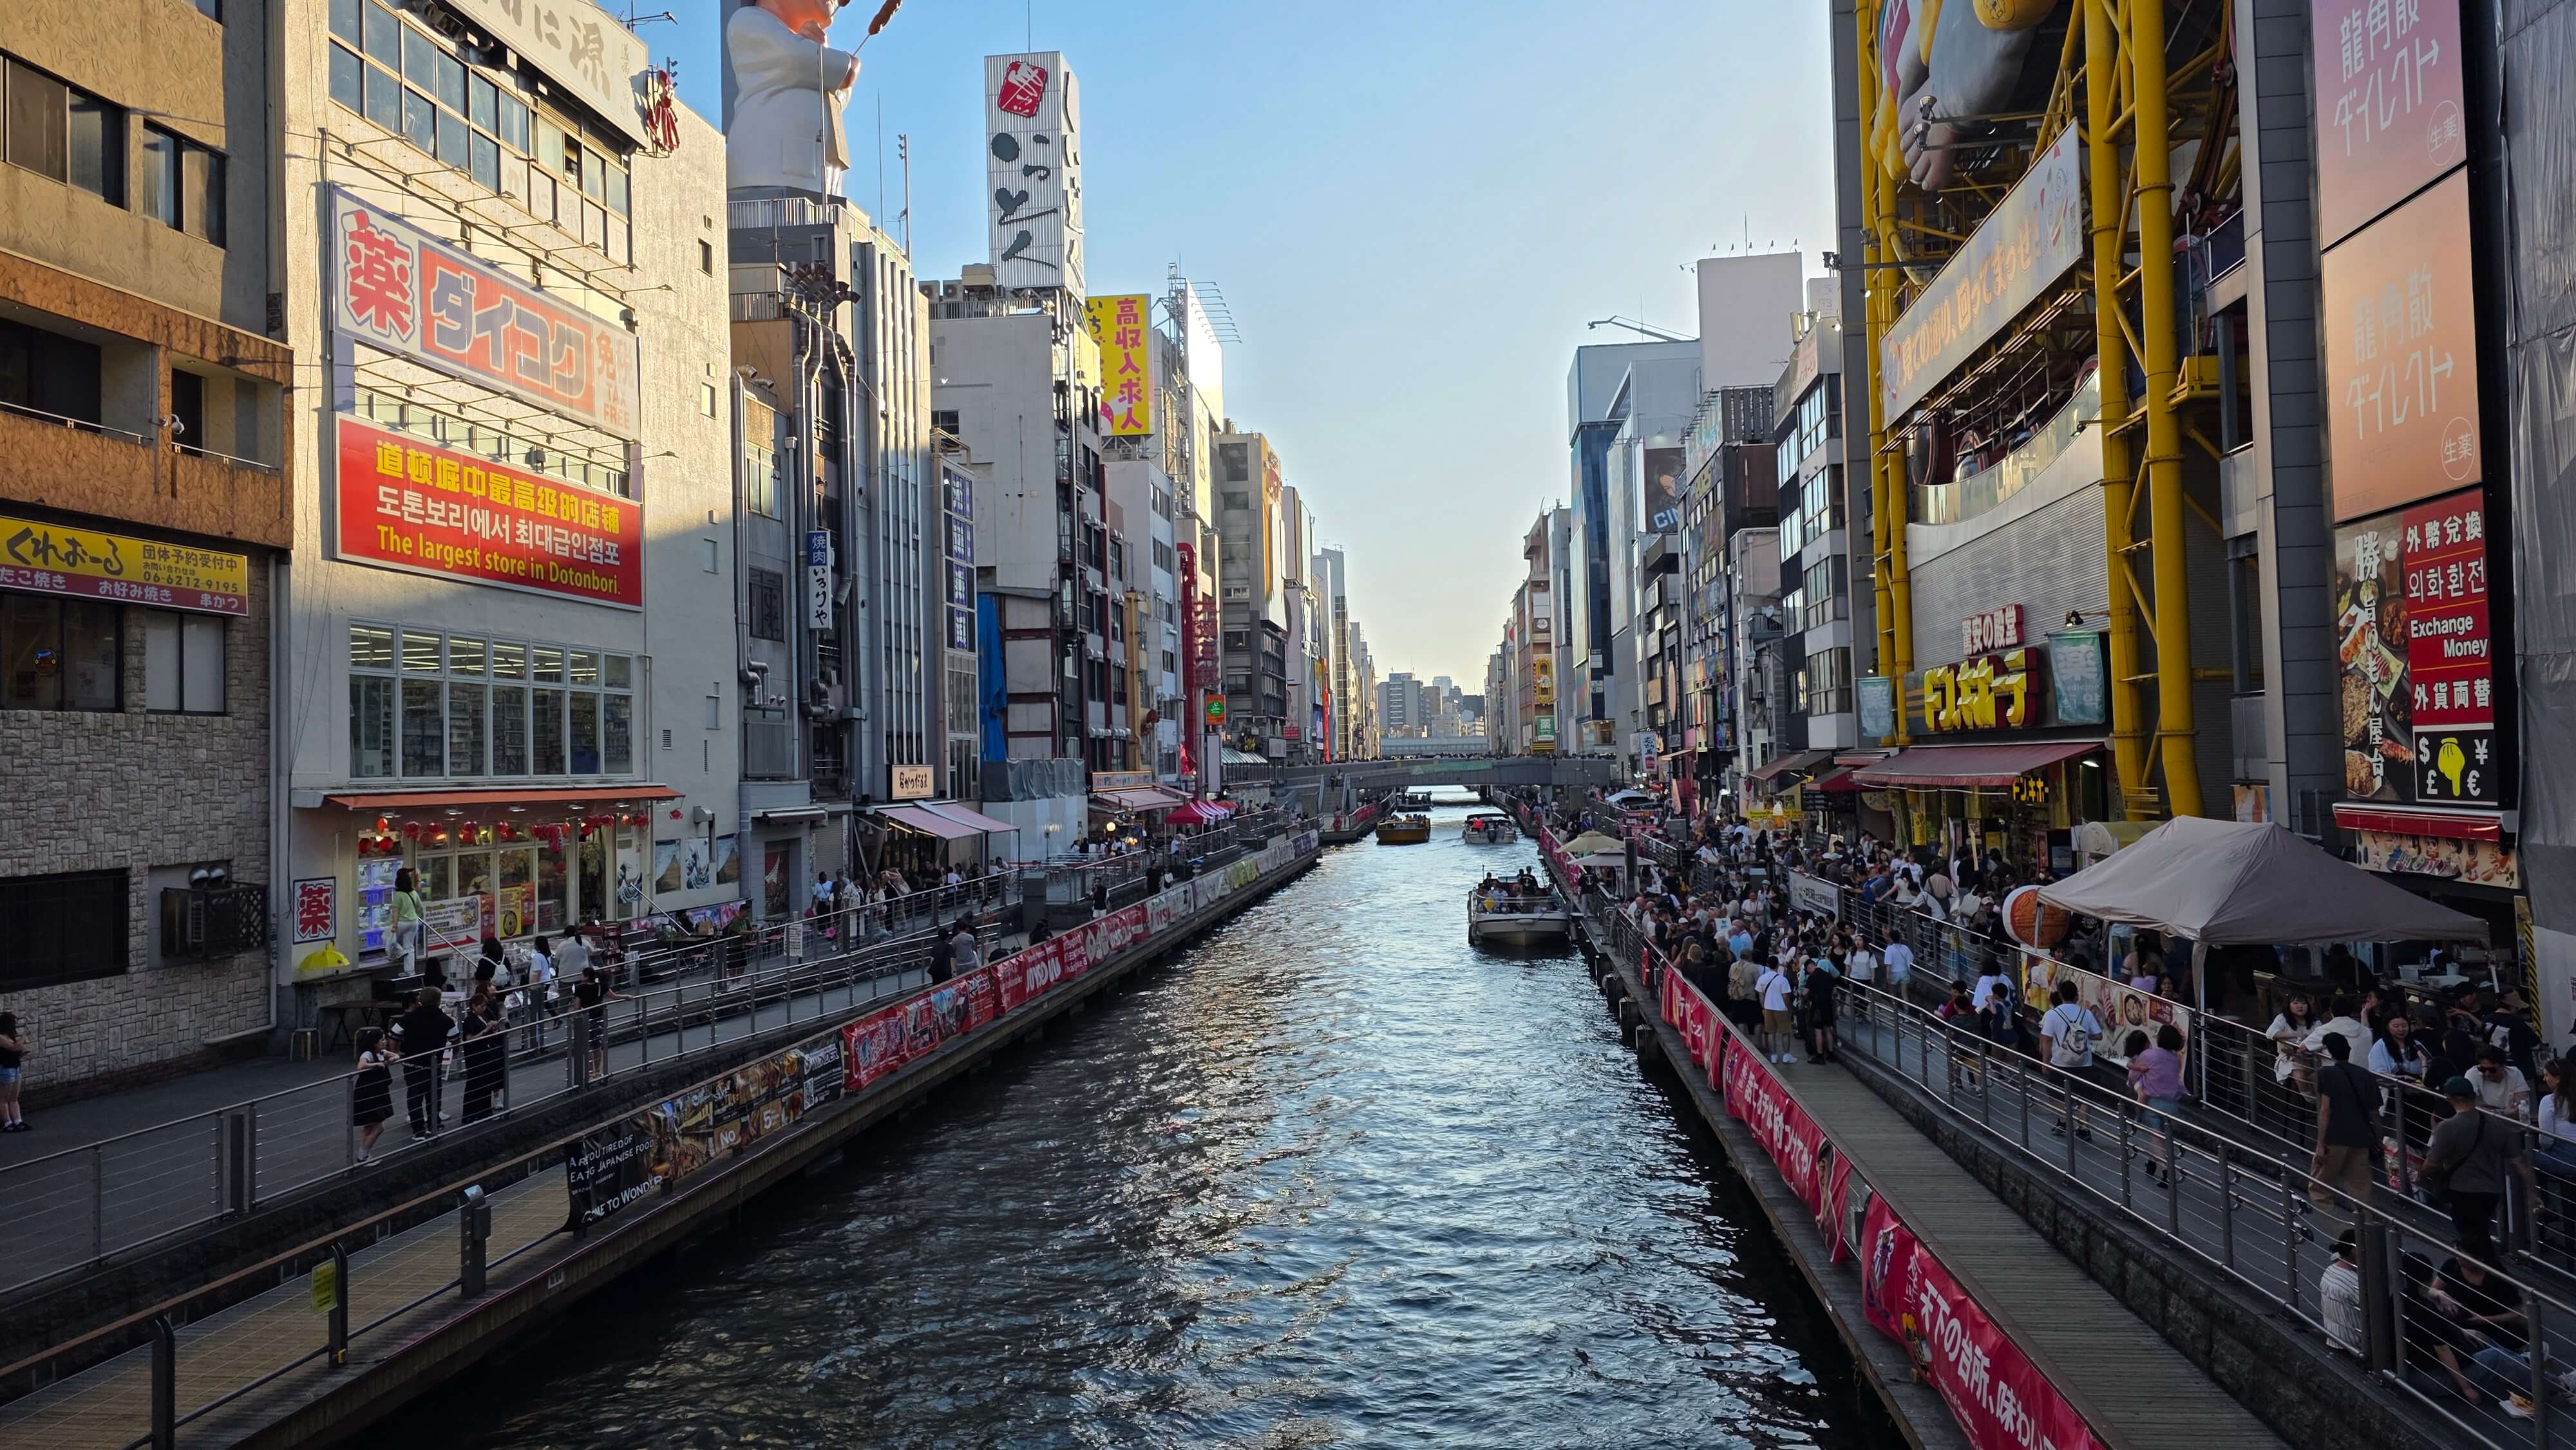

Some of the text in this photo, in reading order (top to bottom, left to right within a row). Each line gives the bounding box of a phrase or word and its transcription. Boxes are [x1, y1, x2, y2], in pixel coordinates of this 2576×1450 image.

[2334, 37, 2439, 156] ダイレクト
[2430, 114, 2457, 154] 生薬
[342, 209, 412, 337] 薬
[2353, 263, 2434, 365] 龍角散
[430, 265, 586, 399] ダイコク
[1115, 297, 1143, 431] 高収入求人
[607, 382, 626, 408] TAX
[2345, 345, 2453, 439] ダイレクト
[603, 402, 630, 429] FREE
[2444, 433, 2472, 464] 生薬
[376, 486, 620, 567] 도톤보리에서 최대급인점포
[2407, 511, 2482, 553] 外幣兌換
[6, 527, 124, 575] くれおーる
[143, 545, 238, 572] 団体予約受付中
[377, 525, 621, 596] The largest store in Dotonbori.
[812, 535, 826, 565] 焼肉
[2354, 531, 2380, 582] 勝
[0, 567, 66, 589] たこ焼き
[143, 562, 196, 576] お問い合わせは
[144, 571, 238, 592] 06-6212-9195
[2409, 557, 2485, 603] 외화환전
[99, 581, 172, 603] お好み焼き
[201, 594, 239, 608] 串かつ
[813, 568, 827, 626] いろりや
[1962, 605, 2017, 655] 驚安の殿堂
[2410, 616, 2473, 639] Exchange
[2444, 639, 2488, 658] Money
[2414, 678, 2492, 710] 外貨両替
[2419, 737, 2488, 765] $ ¥
[2427, 769, 2480, 796] £ €
[299, 881, 331, 938] 薬
[598, 1148, 634, 1172] JAPANESE
[602, 1140, 623, 1156] TIRED
[624, 1134, 633, 1145] OF
[607, 1198, 619, 1211] TO
